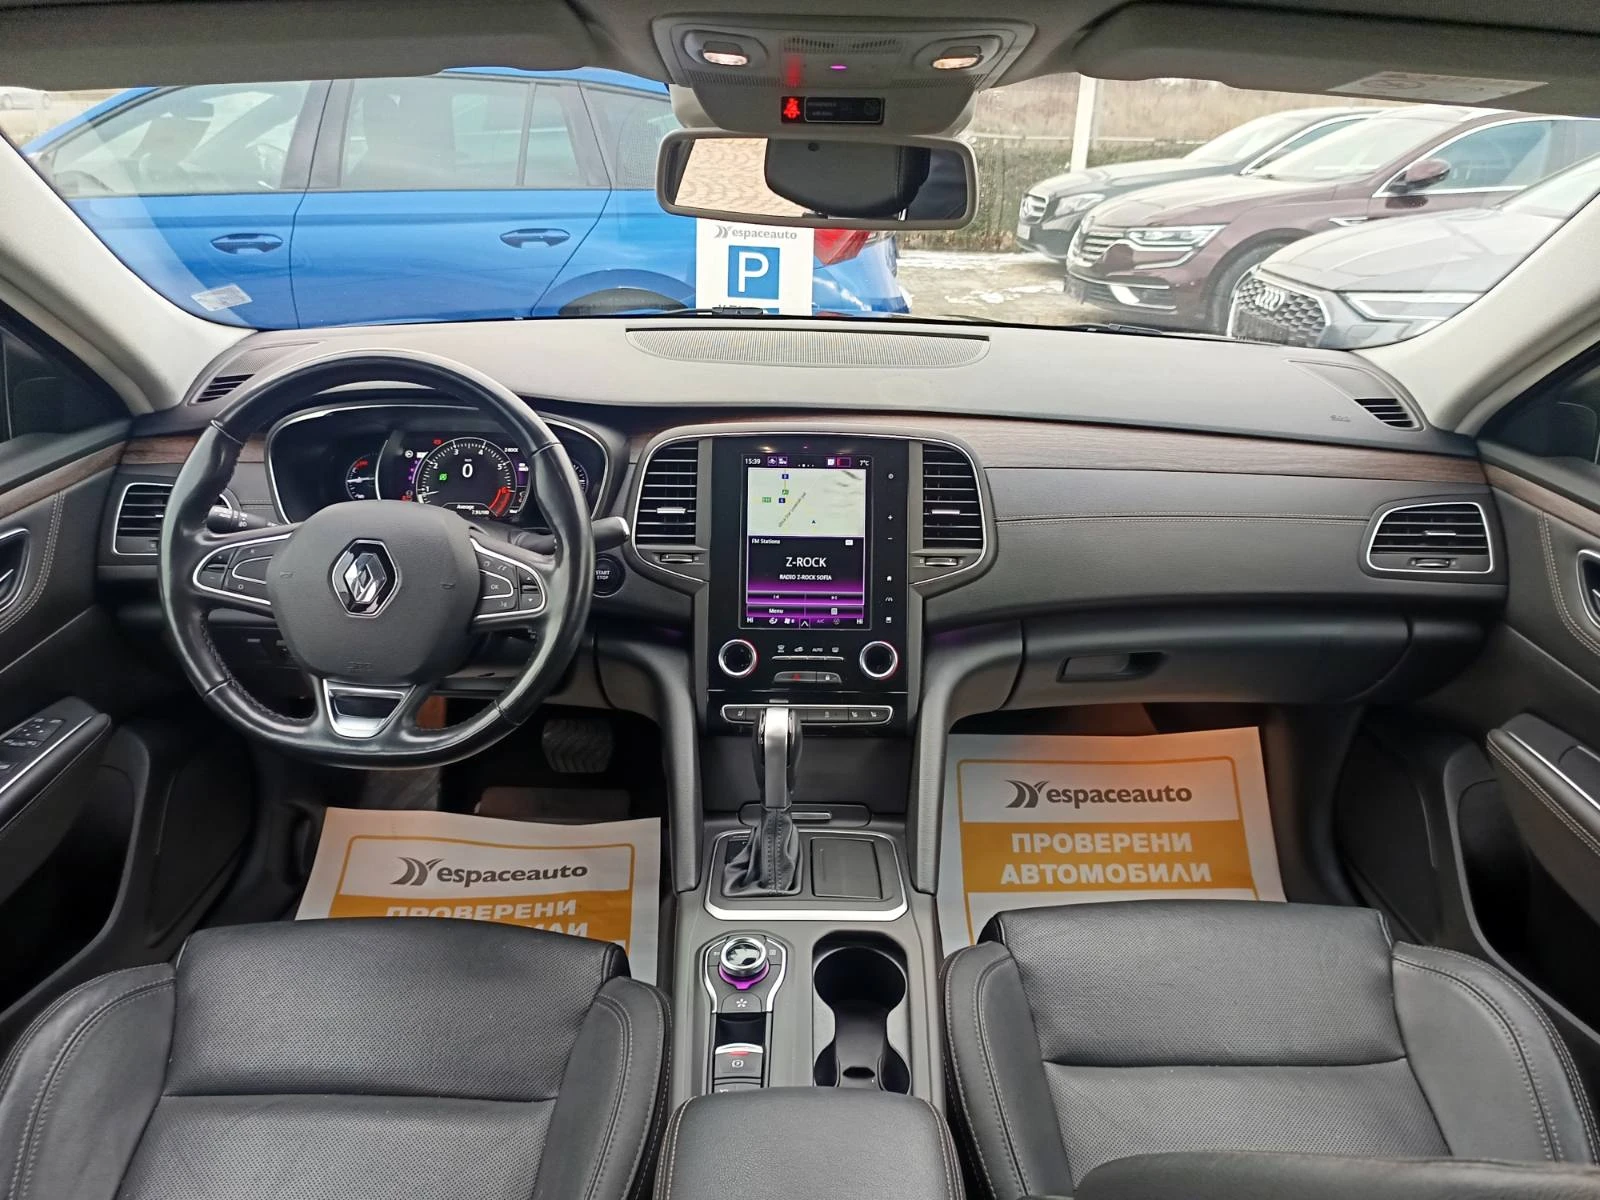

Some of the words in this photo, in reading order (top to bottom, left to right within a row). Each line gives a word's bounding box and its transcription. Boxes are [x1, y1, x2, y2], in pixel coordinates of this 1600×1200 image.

[732, 228, 798, 240] espaceauto
[737, 251, 769, 293] P
[453, 448, 459, 456] 3
[478, 448, 484, 456] 4
[497, 463, 503, 471] 5
[745, 457, 761, 465] 15:39
[462, 463, 473, 478] 0
[785, 556, 827, 568] Z-ROCK
[779, 573, 797, 581] RADIO
[1046, 785, 1192, 809] espaceauto
[1010, 832, 1193, 854] ПРОВЕРЕНИ
[436, 862, 588, 888] espaceauto
[1000, 862, 1212, 885] АВТОМОБИЛИ
